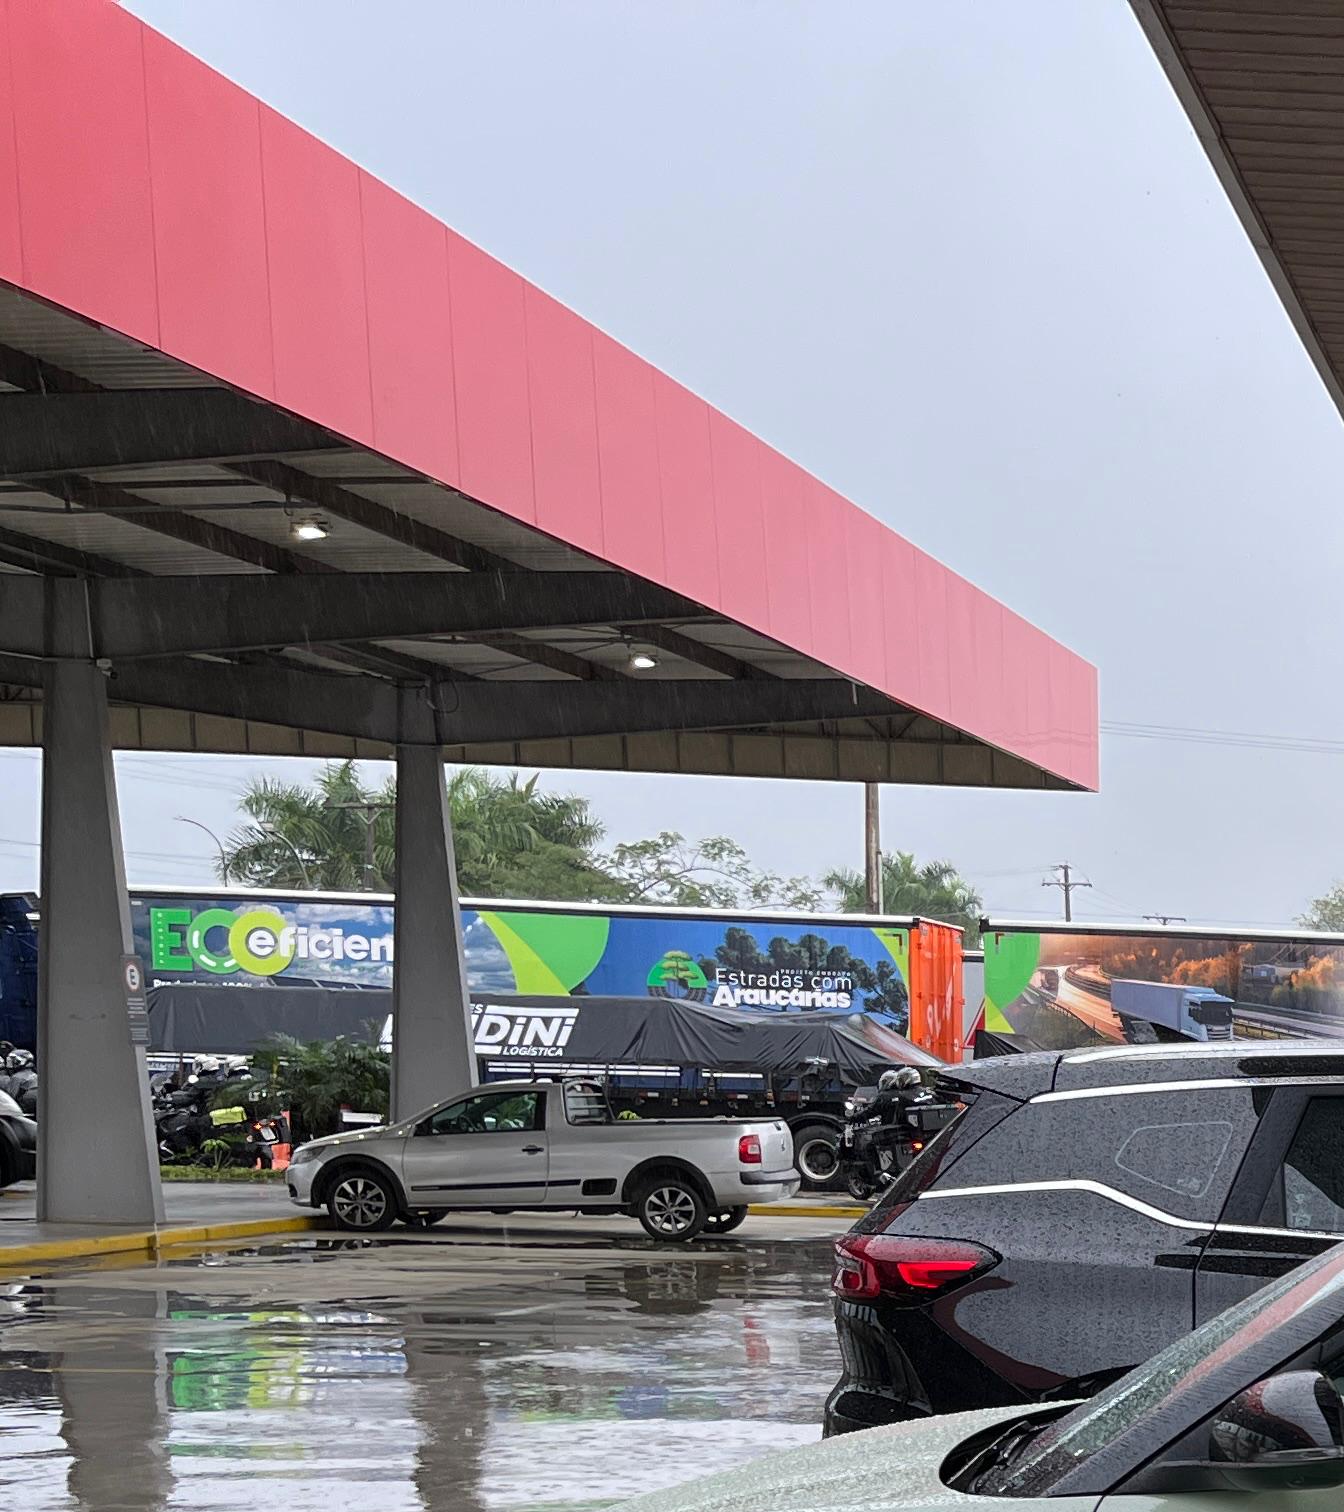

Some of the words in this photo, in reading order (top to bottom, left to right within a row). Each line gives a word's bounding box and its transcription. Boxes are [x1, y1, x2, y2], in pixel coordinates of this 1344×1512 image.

[248, 926, 394, 962] eficien
[715, 968, 804, 988] Estradas
[811, 975, 852, 990] com
[712, 985, 851, 1008] Araucárias
[502, 1045, 564, 1058] LOGÍSTICA
